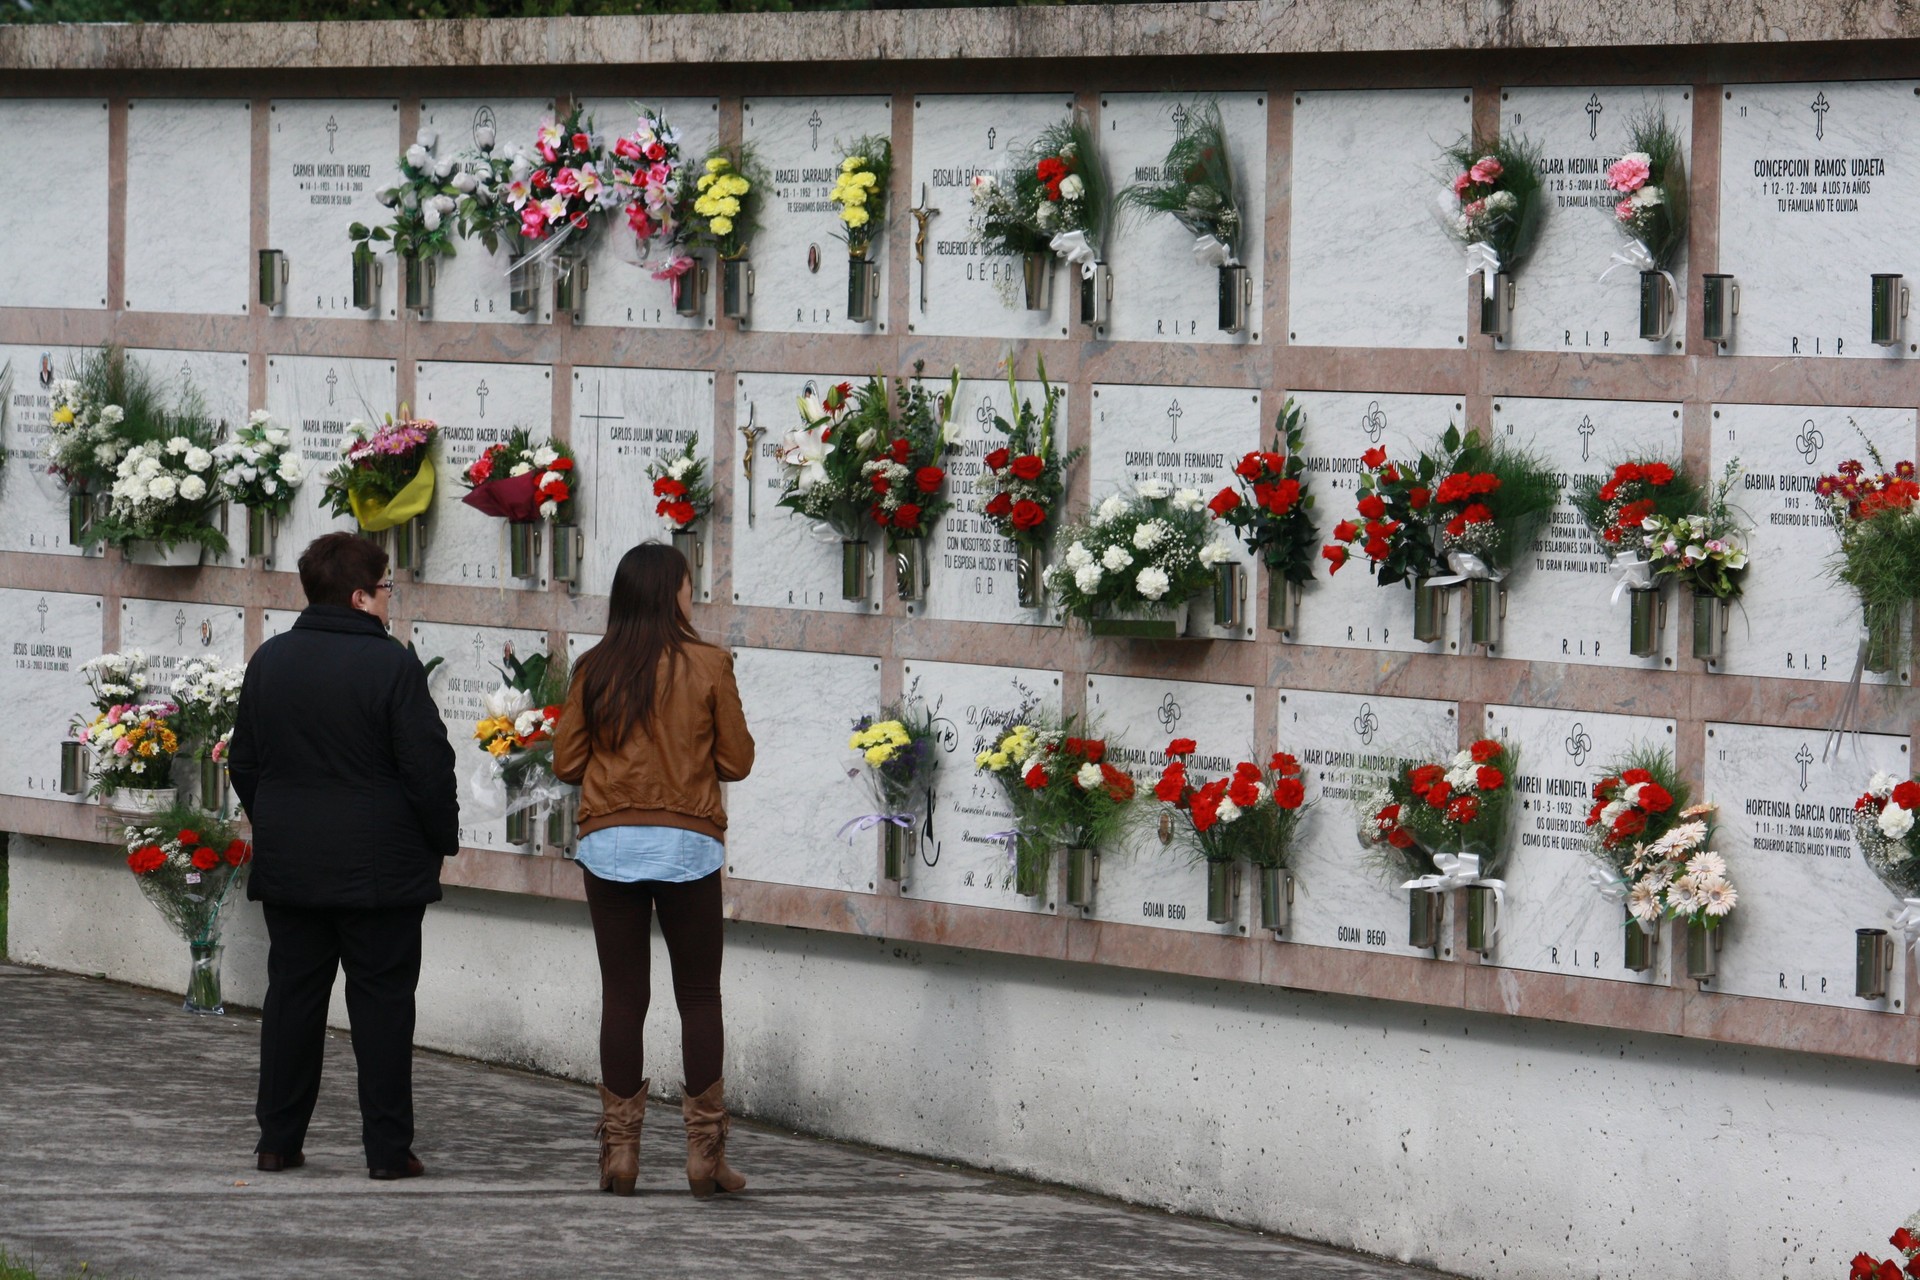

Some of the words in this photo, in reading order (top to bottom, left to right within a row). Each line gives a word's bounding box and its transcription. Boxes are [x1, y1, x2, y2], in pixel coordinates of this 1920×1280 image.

[292, 164, 315, 177] CARMEN
[317, 164, 345, 178] MORENTIN
[347, 164, 370, 178] REMIREZ
[1136, 166, 1160, 182] MIGUEL
[1540, 158, 1564, 174] CLARA
[1568, 158, 1598, 174] MEDINA
[1754, 159, 1810, 178] CONCEPCION
[1814, 158, 1847, 177] RAMOS
[1851, 158, 1885, 177] UDAETA
[775, 168, 800, 183] ARACELI
[802, 168, 832, 182] SARRALDE
[932, 165, 963, 187] ROSALÍA
[1578, 180, 1592, 191] 2004
[1771, 182, 1780, 195] 12
[1786, 182, 1794, 195] 12
[1800, 182, 1818, 194] 2004
[1822, 181, 1828, 194] A
[1828, 181, 1841, 194] LOS
[1842, 181, 1851, 194] 76
[1852, 178, 1871, 194] AÑOS
[788, 202, 793, 212] TE
[794, 202, 816, 212] SEGUIMOS
[1558, 196, 1565, 208] TU
[1566, 196, 1589, 208] FAMILIA
[1590, 196, 1599, 208] NO
[1600, 196, 1606, 208] TE
[1778, 199, 1786, 212] TU
[1788, 199, 1814, 212] FAMILIA
[1816, 199, 1825, 212] NO
[1827, 199, 1834, 212] TE
[1836, 199, 1858, 212] OLVIDA
[937, 241, 968, 256] RECUERDO
[969, 241, 978, 256] DE
[980, 242, 993, 256] TUS
[1158, 319, 1164, 334] R.
[1175, 320, 1180, 335] I.
[1192, 320, 1196, 335] P.
[1792, 336, 1801, 354] R.
[1816, 337, 1822, 354] I.
[1837, 338, 1843, 355] P.
[13, 394, 34, 407] ANTONIO
[302, 420, 320, 433] MARIA
[322, 421, 344, 434] HERRAN
[444, 426, 474, 440] FRANCISCO
[476, 428, 498, 442] RACERO
[610, 426, 632, 440] CARLOS
[632, 428, 653, 442] JULIAN
[656, 428, 673, 443] SAINZ
[1125, 451, 1154, 466] CARMEN
[1157, 452, 1181, 468] CODON
[1184, 452, 1224, 469] FERNANDEZ
[1307, 457, 1331, 472] MARIA
[1332, 458, 1364, 474] DOROTEA
[1160, 473, 1174, 482] 1910
[1200, 474, 1214, 484] 2004
[1745, 474, 1776, 491] GABINA
[952, 480, 961, 494] LO
[962, 480, 974, 494] QUE
[956, 498, 964, 512] EL
[946, 518, 955, 532] LO
[956, 519, 968, 533] QUE
[970, 520, 978, 534] TU
[980, 520, 992, 534] NOS
[1553, 512, 1575, 524] DESEOS
[1770, 513, 1800, 526] RECUERDO
[1802, 514, 1810, 527] DE
[1811, 514, 1818, 527] TU
[1552, 526, 1577, 540] FORMAN
[1578, 527, 1591, 540] UNA
[947, 536, 959, 550] CON
[960, 537, 991, 552] NOSOTROS
[992, 538, 1001, 552] SE
[1545, 540, 1578, 554] ESLABONES
[1580, 542, 1592, 554] SON
[944, 554, 952, 568] TU
[954, 555, 976, 570] ESPOSA
[978, 556, 996, 571] HIJOS
[1536, 558, 1544, 570] TU
[1546, 559, 1562, 571] GRAN
[1564, 560, 1588, 572] FAMILIA
[1590, 561, 1598, 573] NO
[1600, 562, 1608, 574] TE
[13, 642, 28, 656] JESUS
[30, 644, 56, 658] LLANDERA
[58, 646, 72, 659] MENA
[150, 655, 160, 668] LUIS
[1788, 652, 1796, 670] R.
[1805, 654, 1810, 670] I.
[1822, 655, 1827, 671] P.
[1106, 748, 1122, 762] JOSE
[1124, 749, 1146, 764] MARIA
[1304, 749, 1323, 764] MARI
[1325, 750, 1355, 768] CARMEN
[1358, 754, 1395, 772] LANDIBAR
[1350, 774, 1364, 785] 1954
[1514, 776, 1542, 794] MIREN
[1546, 778, 1587, 799] MENDIETA
[1322, 786, 1348, 800] RECUERDO
[1350, 788, 1356, 800] DE
[1558, 802, 1572, 814] 1932
[1746, 798, 1790, 818] HORTENSIA
[1794, 803, 1825, 822] GARCIA
[1830, 806, 1856, 824] ORTEG
[1536, 817, 1545, 830] OS
[1546, 818, 1569, 833] QUIERO
[1522, 833, 1540, 847] COMO
[1542, 834, 1550, 848] OS
[1552, 836, 1560, 849] HE
[1790, 825, 1804, 837] 2004
[1807, 826, 1812, 838] A
[1812, 827, 1824, 840] LOS
[1834, 826, 1850, 842] AÑOS
[1754, 838, 1785, 853] RECUERDO
[1786, 841, 1794, 854] DE
[1794, 842, 1806, 854] TUS
[1808, 842, 1824, 856] HIJOS
[1830, 846, 1850, 859] NIETOS
[1142, 902, 1164, 918] GOIAN
[1168, 904, 1186, 920] BEGO
[1338, 926, 1360, 944] GOIAN
[1366, 930, 1386, 946] BEGO
[1779, 972, 1788, 990] R.
[1802, 974, 1807, 992] I.
[1821, 976, 1826, 994] P.
